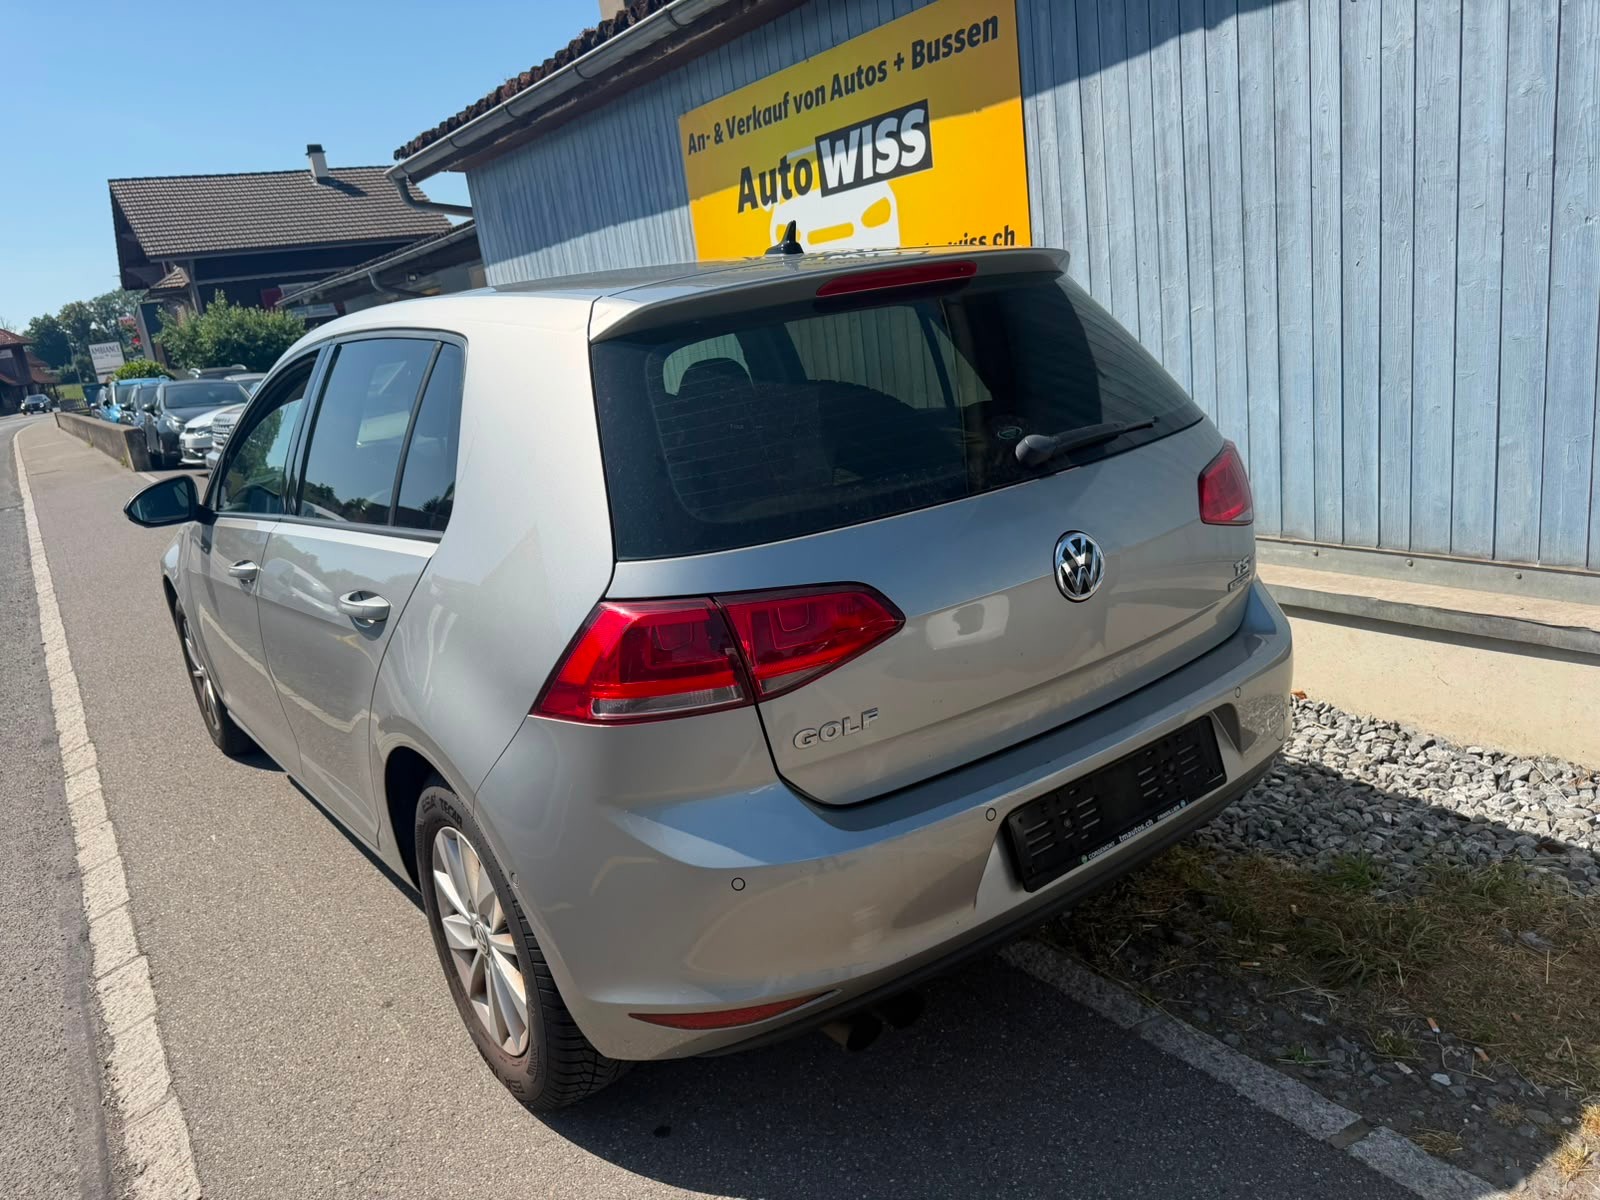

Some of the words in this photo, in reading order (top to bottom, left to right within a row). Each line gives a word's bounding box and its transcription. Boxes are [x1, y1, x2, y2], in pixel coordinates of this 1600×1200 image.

[688, 132, 710, 155] An-
[713, 121, 724, 143] &
[726, 91, 790, 139] Verkauf
[792, 84, 826, 114] von
[830, 60, 888, 101] Autos
[893, 52, 905, 72] +
[911, 15, 999, 70] Bussen
[737, 154, 813, 213] Auto
[819, 108, 927, 189] WISS
[793, 707, 879, 750] GOLF
